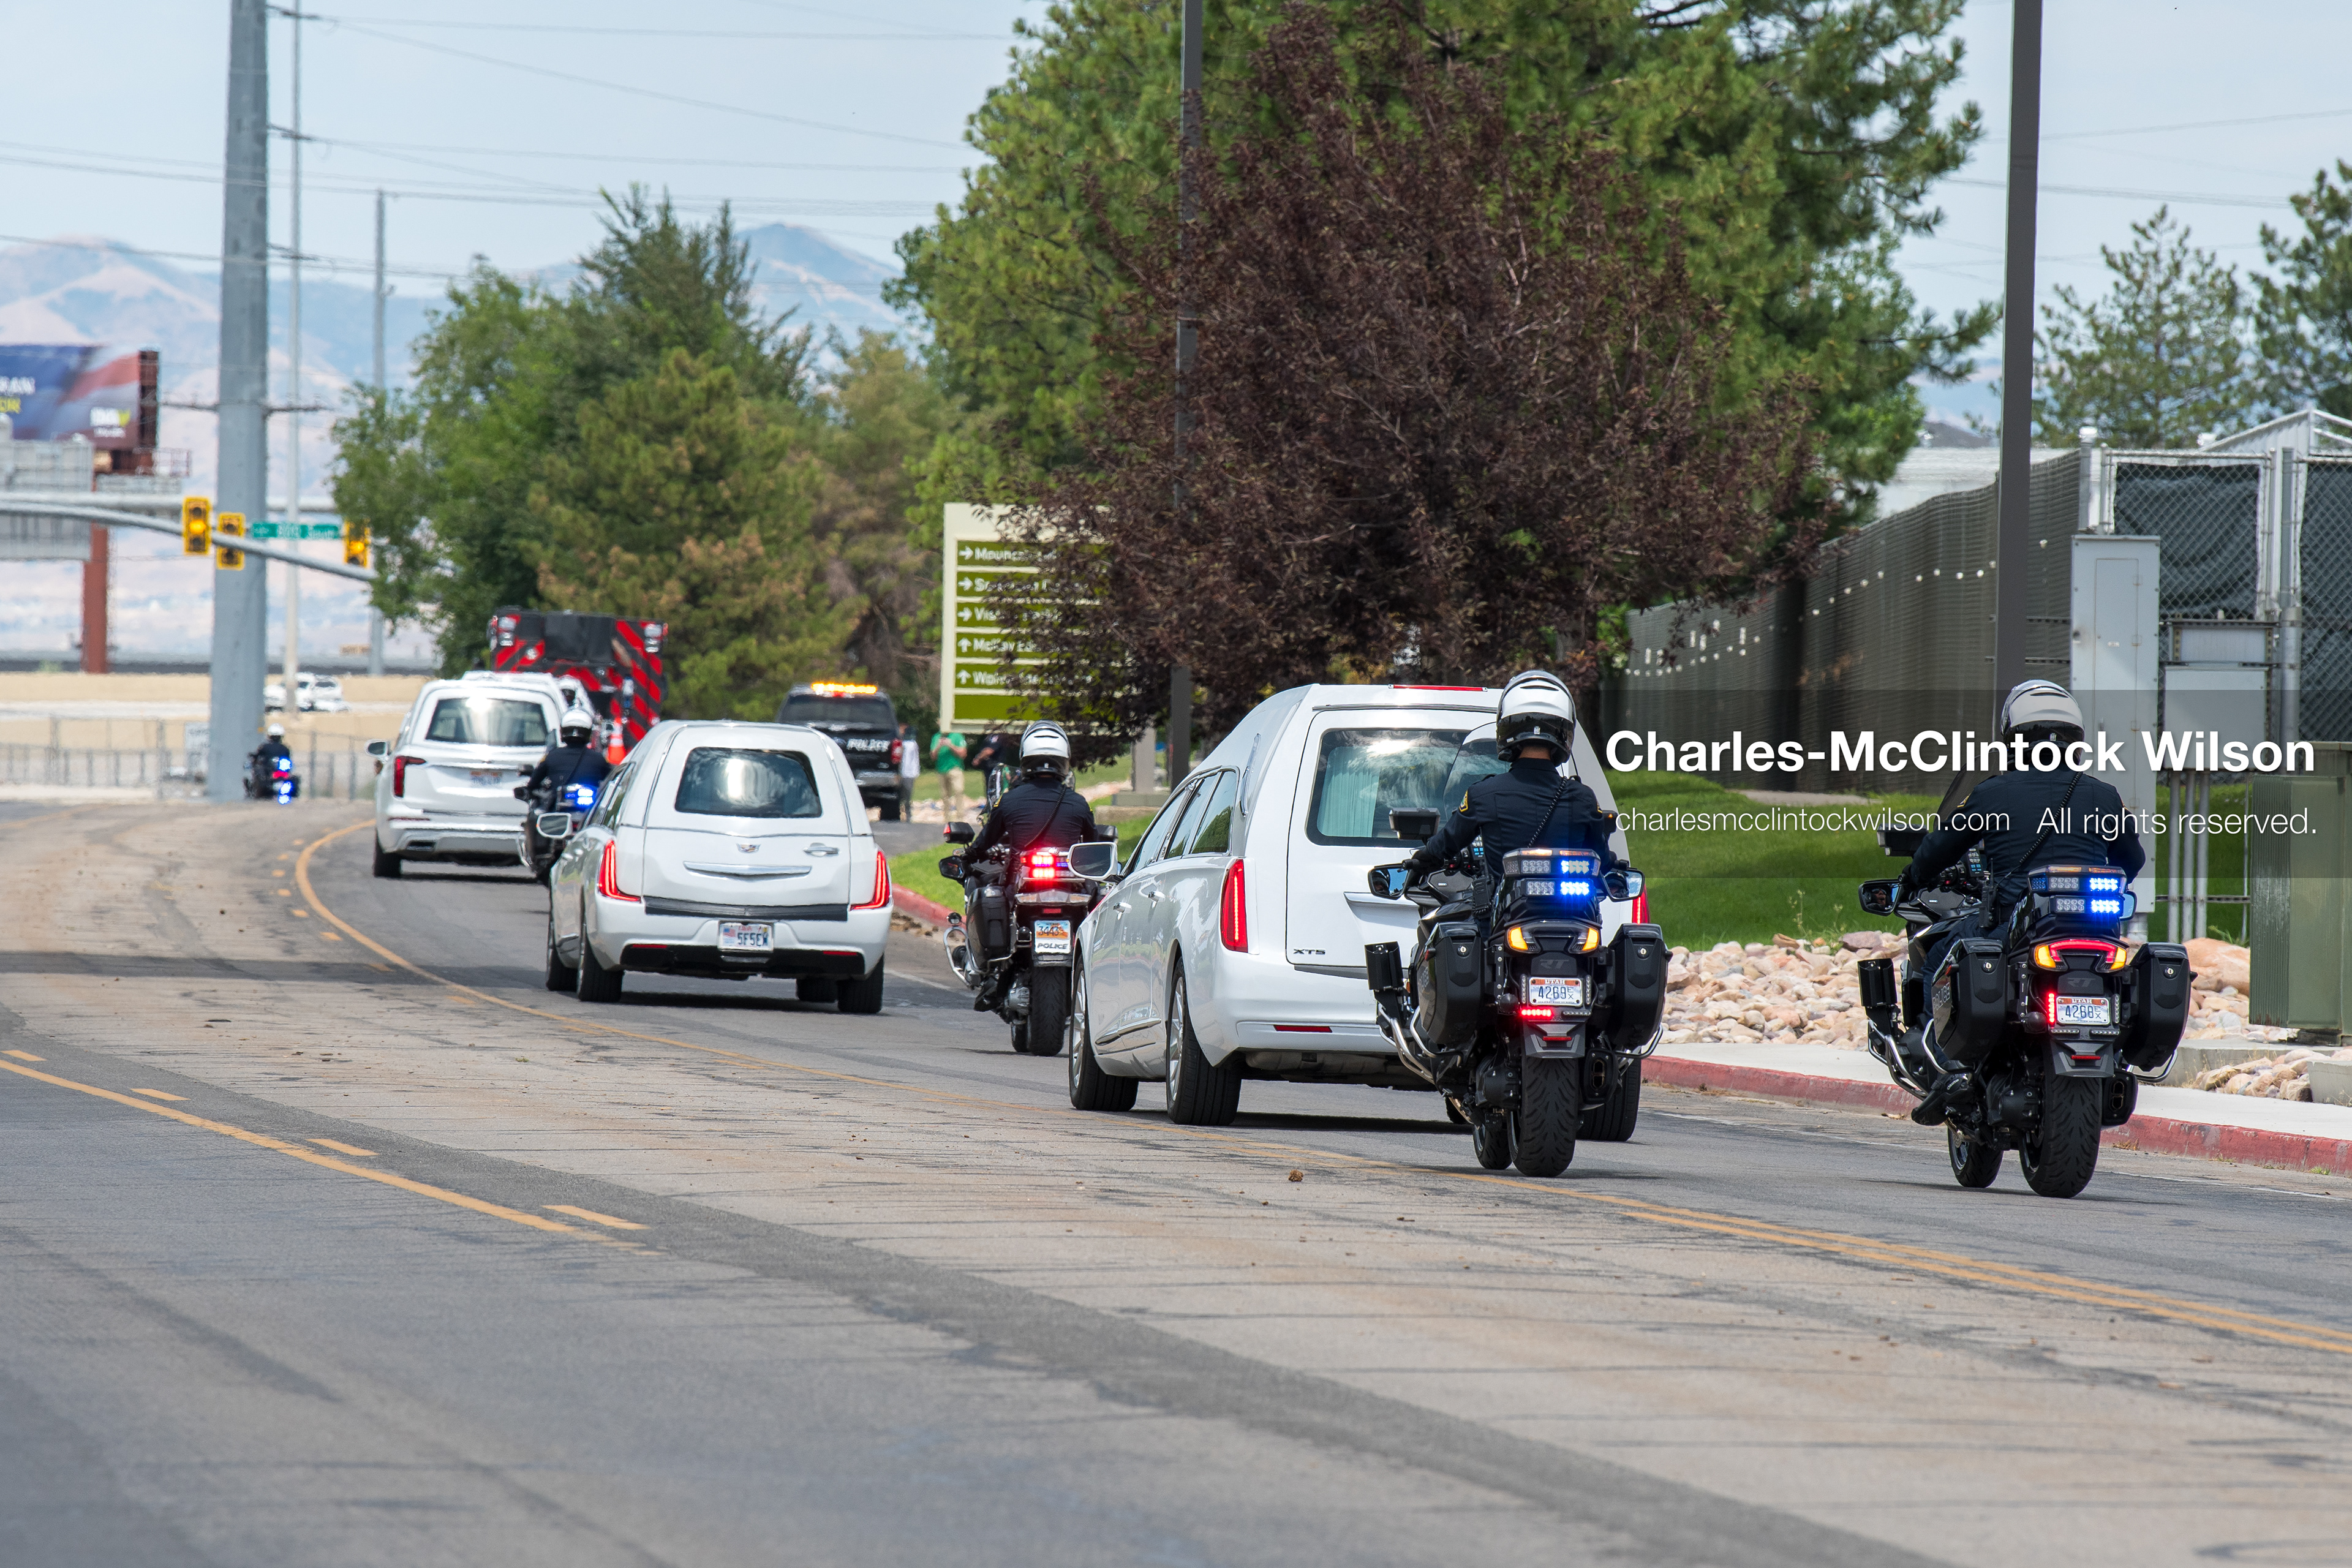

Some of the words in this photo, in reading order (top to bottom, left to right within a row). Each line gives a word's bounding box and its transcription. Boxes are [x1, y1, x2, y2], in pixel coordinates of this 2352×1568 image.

[846, 738, 891, 752] POLICE
[1538, 986, 1567, 1000] 4269
[2065, 1005, 2094, 1019] 4268
